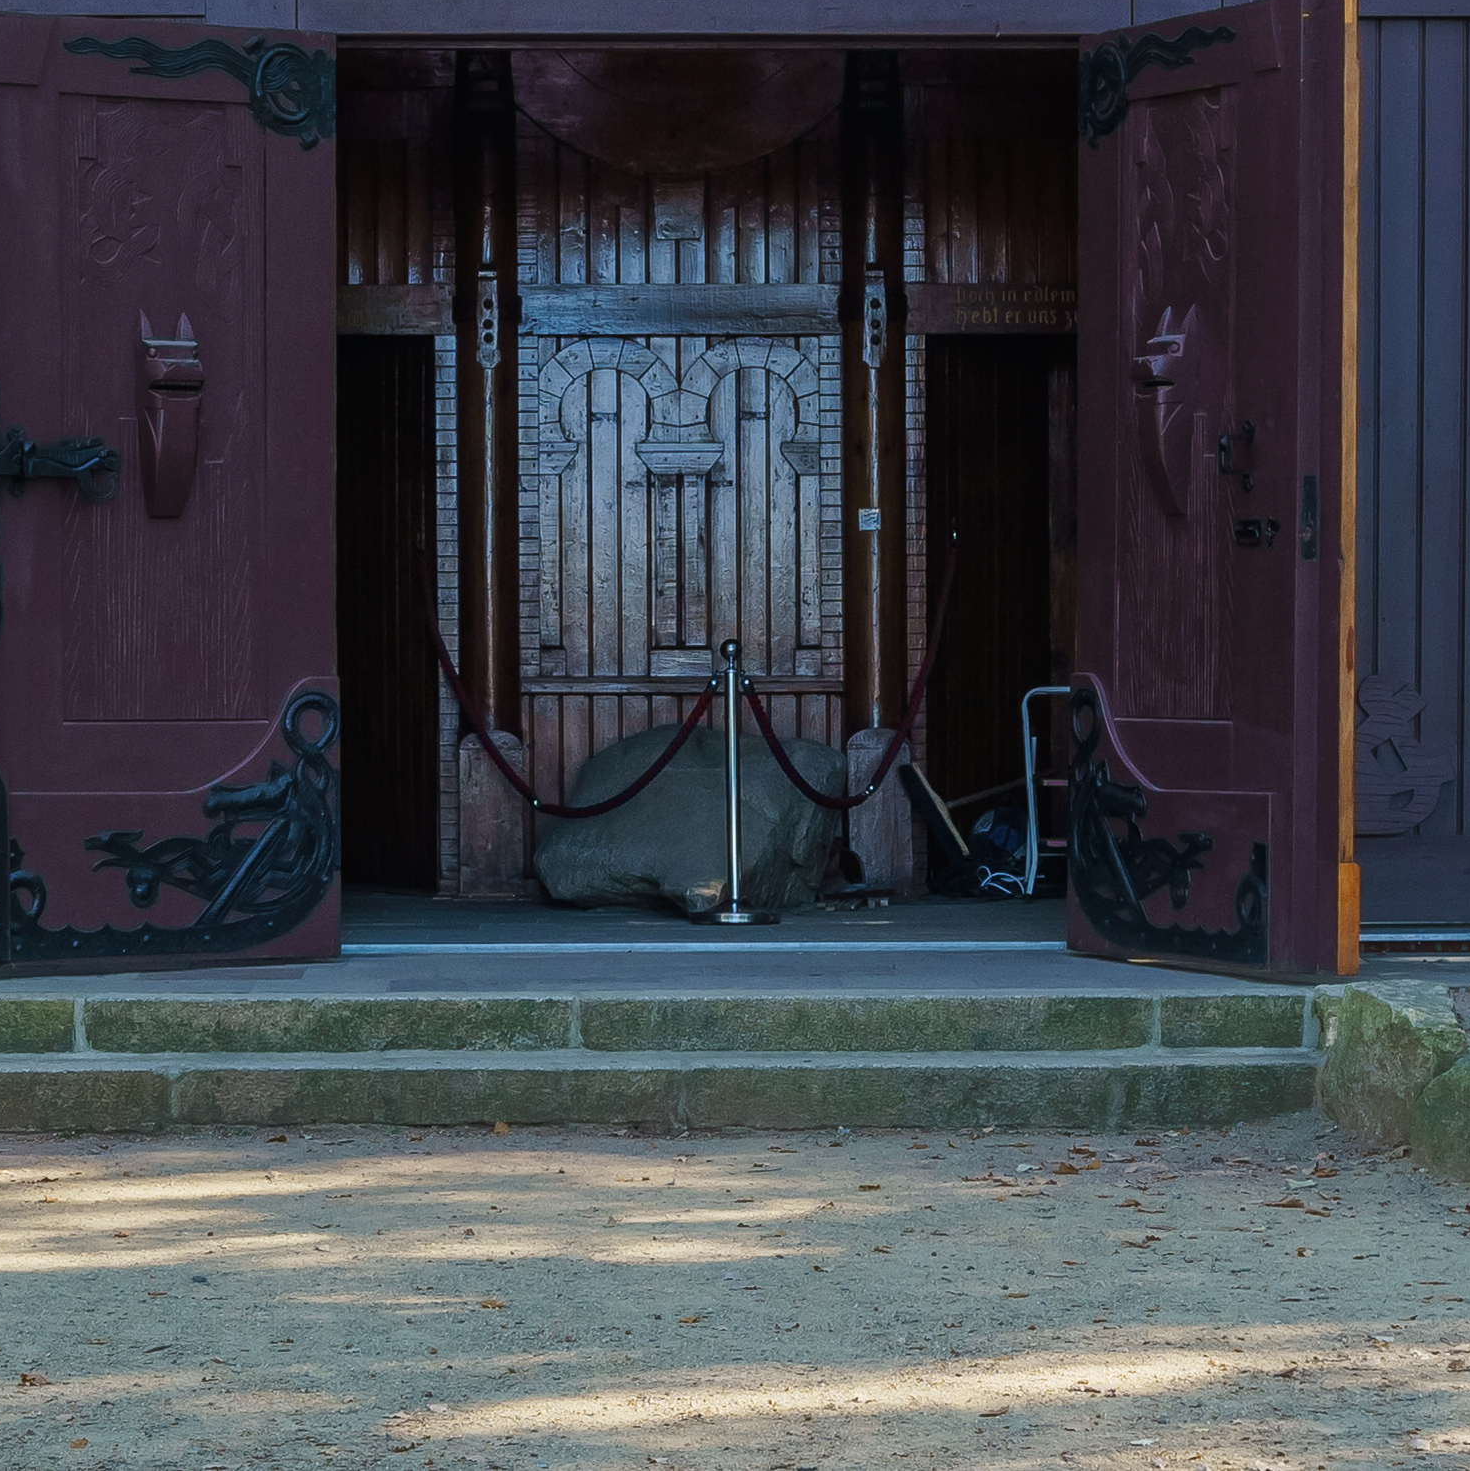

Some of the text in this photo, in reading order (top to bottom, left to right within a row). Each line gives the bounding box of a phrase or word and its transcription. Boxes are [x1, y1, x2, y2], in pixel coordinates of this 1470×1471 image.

[1002, 289, 1017, 303] in
[1005, 310, 1022, 325] er
[1028, 309, 1058, 325] uns
